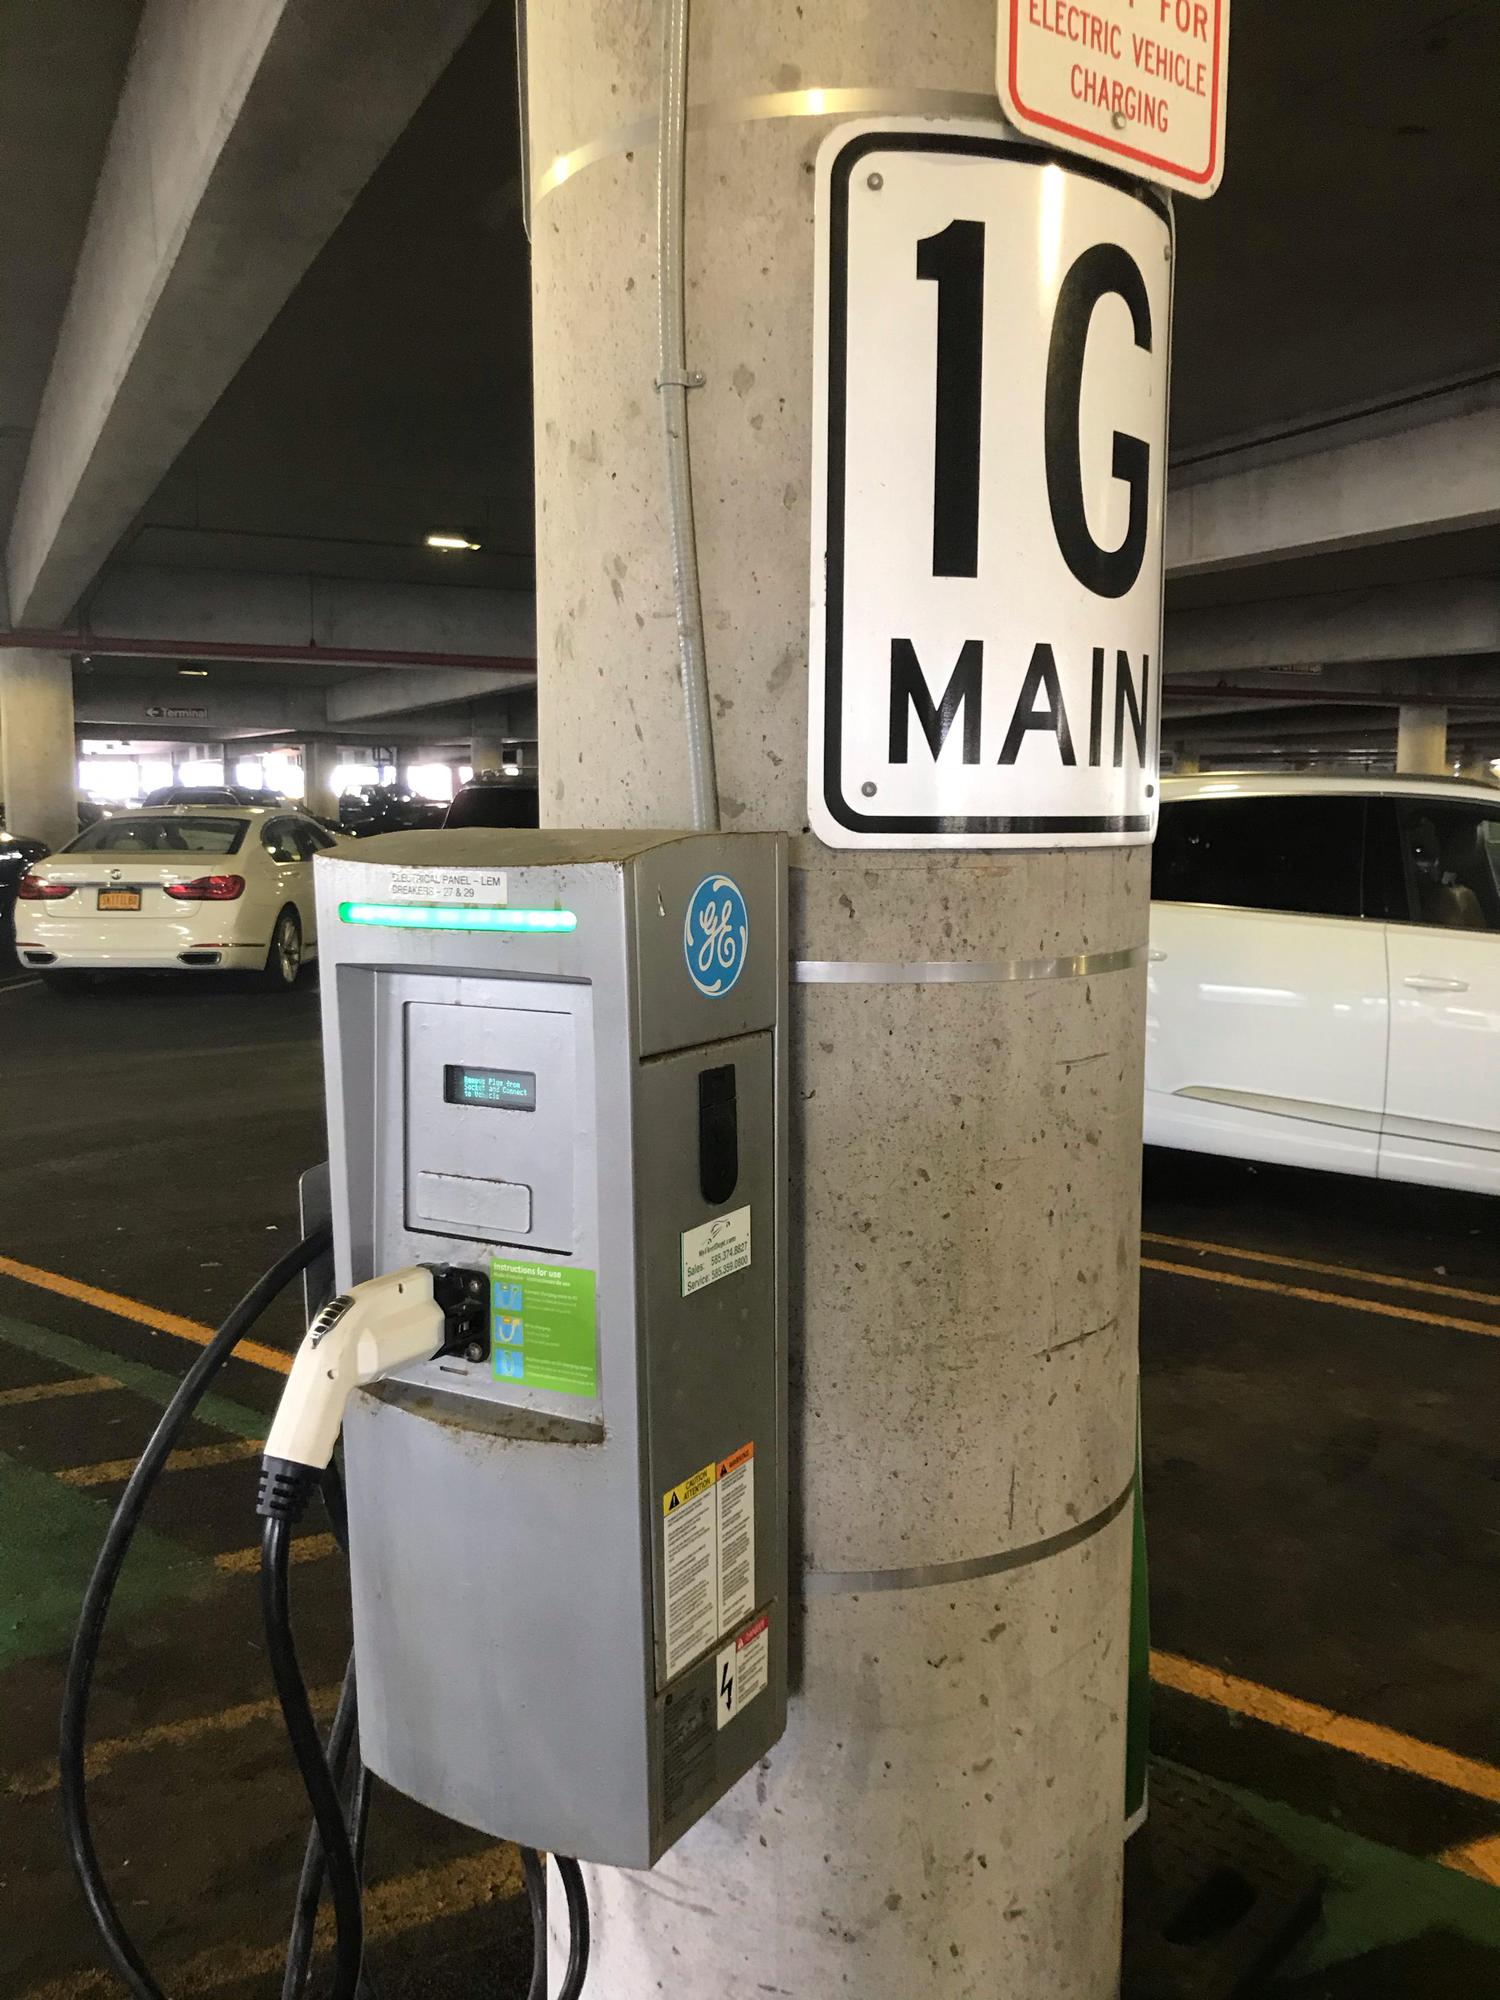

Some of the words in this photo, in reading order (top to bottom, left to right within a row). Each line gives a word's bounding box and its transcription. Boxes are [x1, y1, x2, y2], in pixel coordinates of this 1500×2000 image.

[1160, 0, 1208, 42] FOR
[1028, 0, 1122, 60] ELECTRIC
[1132, 33, 1207, 97] VEHICLE
[1071, 63, 1169, 133] CHARGING
[916, 218, 1153, 599] 1G
[161, 707, 208, 718] Terminal
[888, 637, 1150, 768] MAIN
[443, 875, 472, 885] PANEL
[481, 876, 501, 886] LEM
[444, 887, 453, 897] 27
[456, 888, 462, 897] &
[464, 888, 475, 897] 29
[502, 1087, 528, 1096] Connect
[493, 1262, 536, 1276] Instructions
[537, 1267, 547, 1277] for
[549, 1270, 562, 1279] use
[684, 1478, 711, 1499] ATTENTION
[685, 1470, 708, 1490] CAUTION
